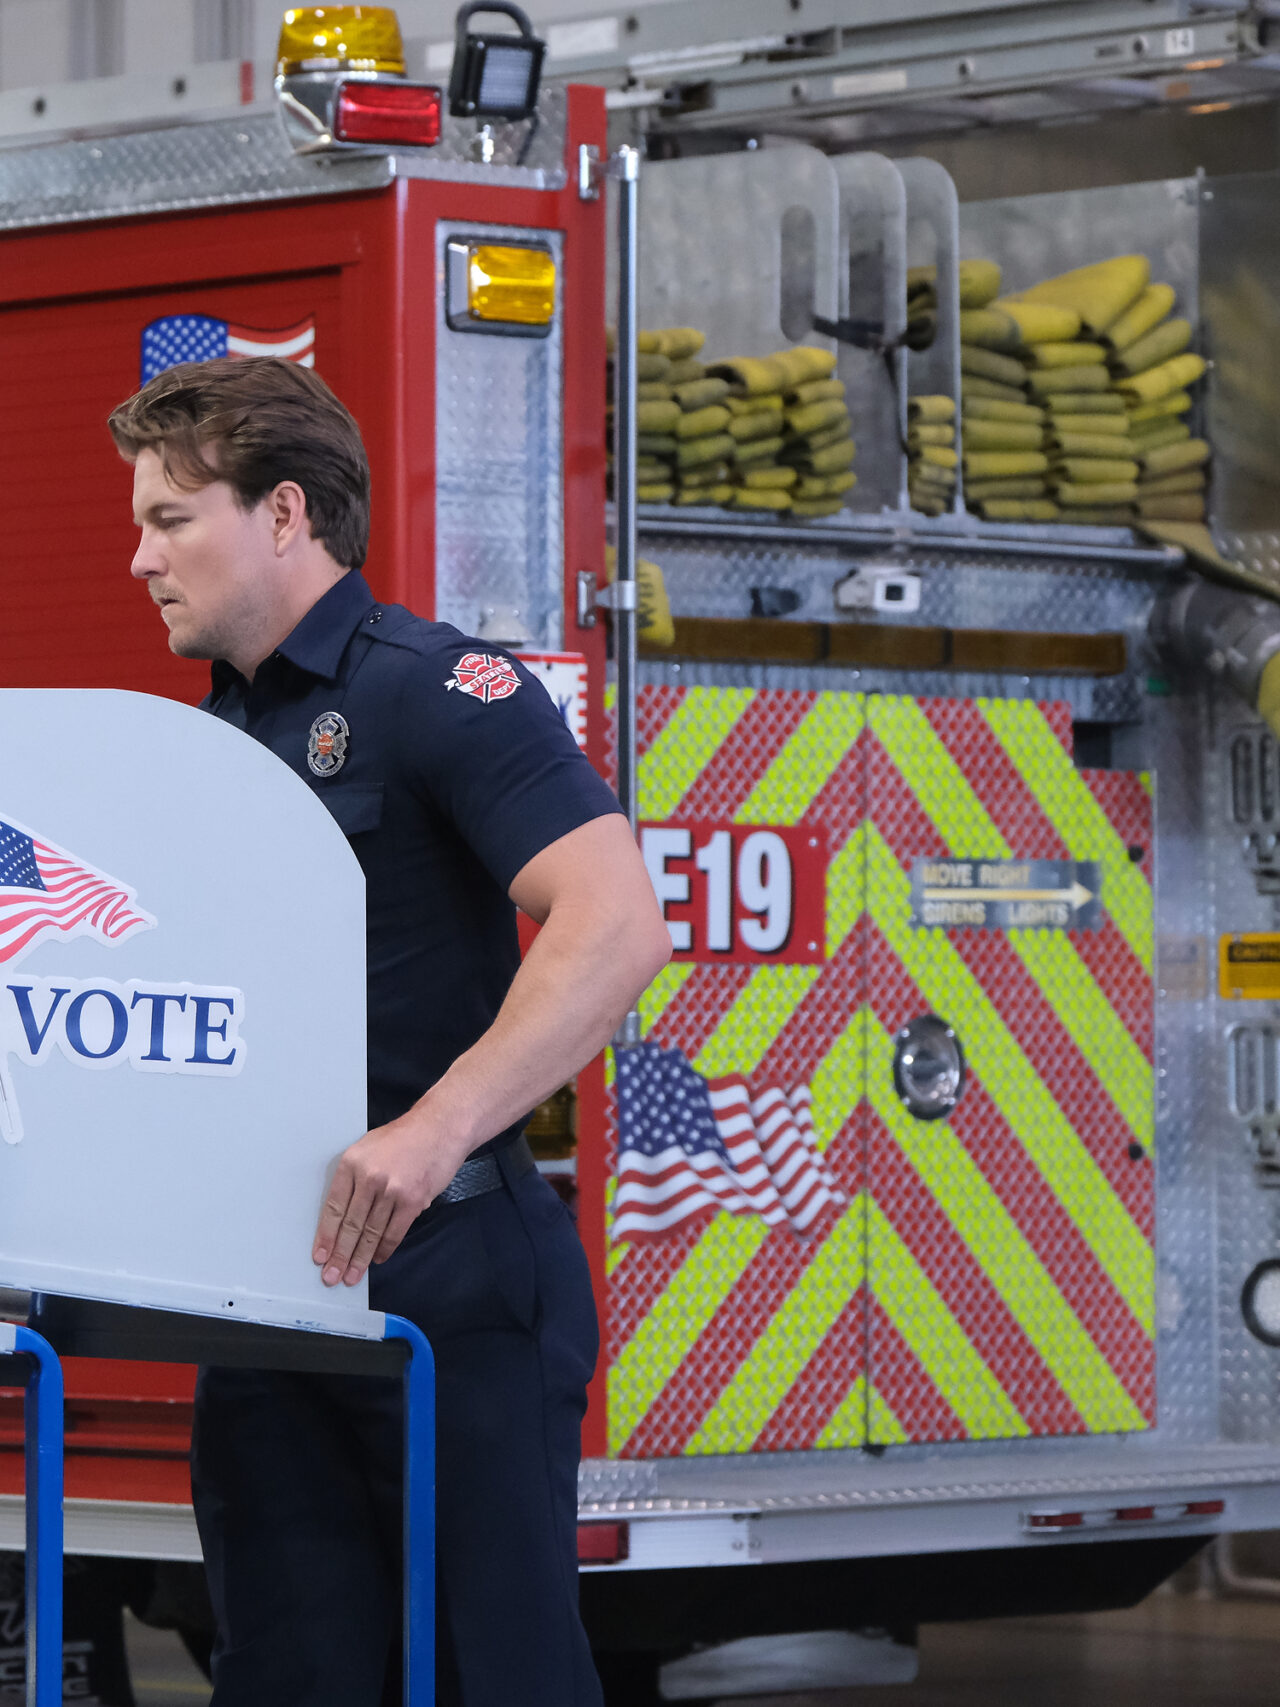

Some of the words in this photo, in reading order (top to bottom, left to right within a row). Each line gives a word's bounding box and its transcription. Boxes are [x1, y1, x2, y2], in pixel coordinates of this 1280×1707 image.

[469, 666, 508, 690] SEATTLE
[492, 682, 511, 696] DEPT
[923, 864, 972, 886] MOVE
[980, 864, 1030, 886] RIGHT
[641, 828, 793, 953] E19
[922, 902, 986, 925] SIRENS
[1009, 902, 1069, 925] LIGHTS
[6, 985, 237, 1066] VOTE
